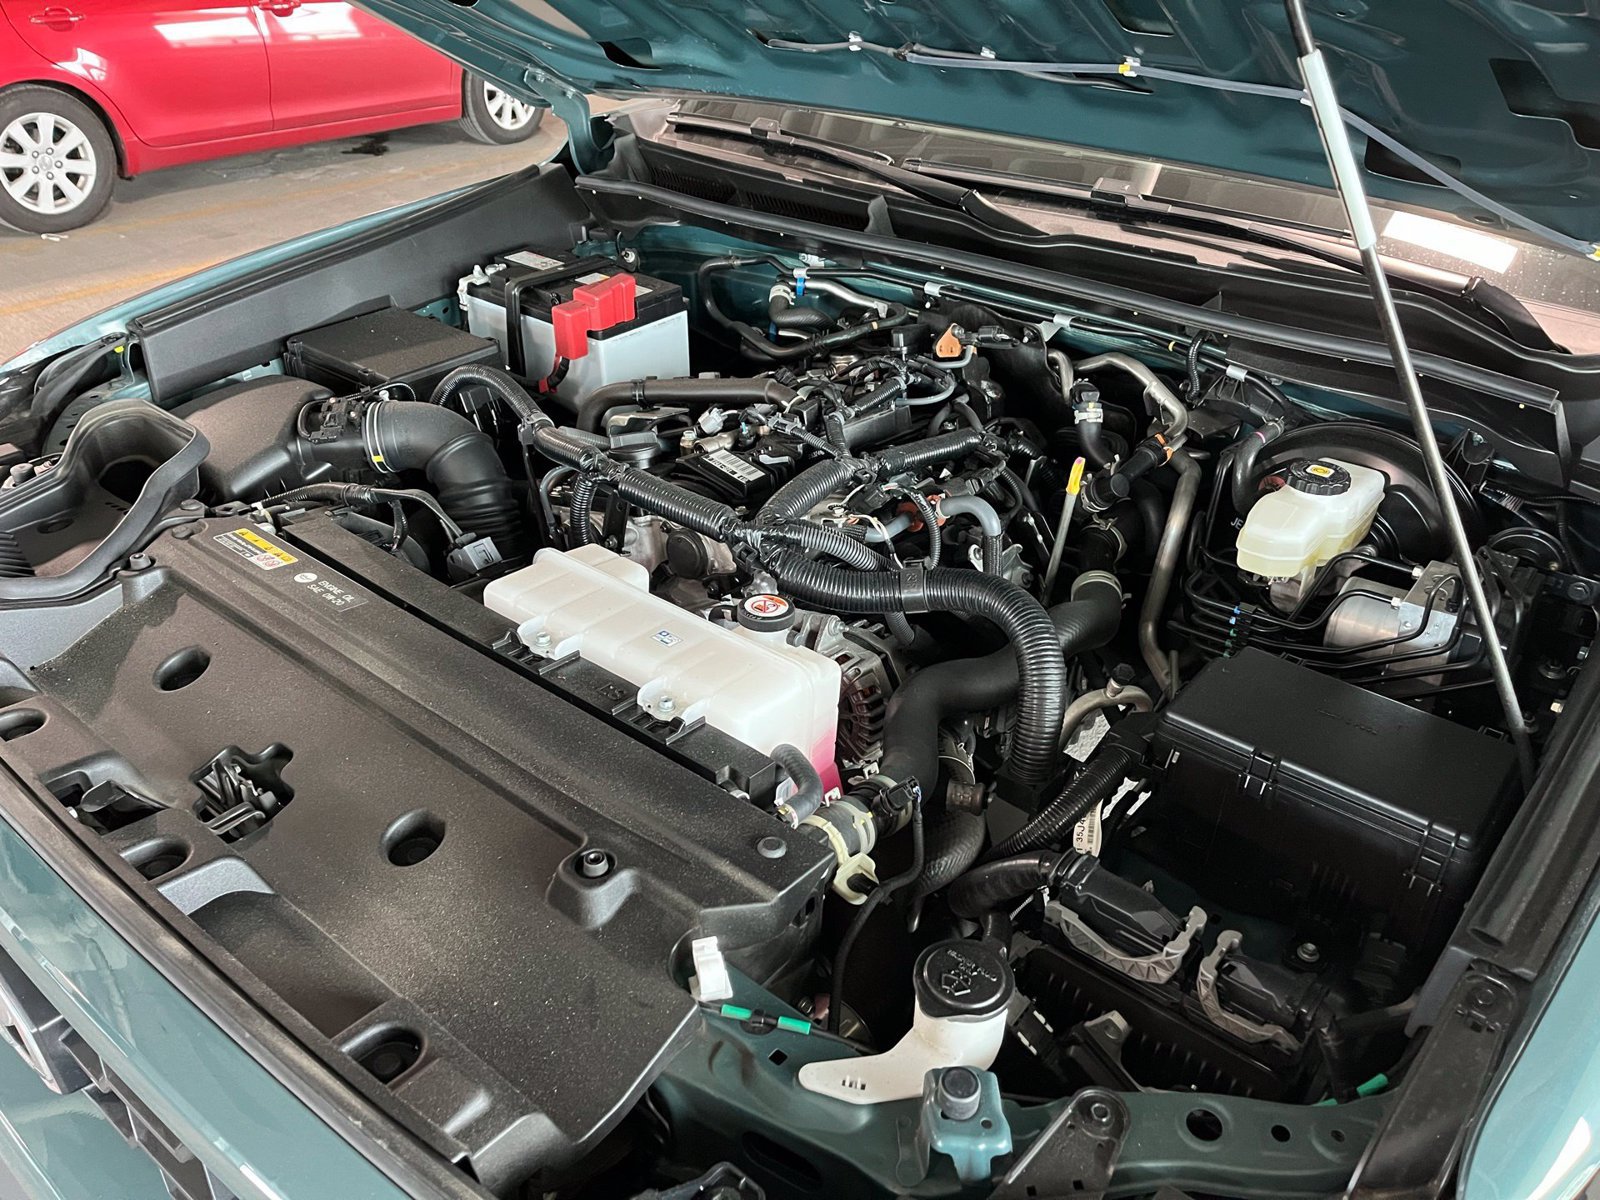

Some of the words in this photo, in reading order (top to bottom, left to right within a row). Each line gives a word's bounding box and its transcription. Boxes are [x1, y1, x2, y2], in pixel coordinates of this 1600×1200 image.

[307, 584, 325, 594] SAE
[318, 580, 344, 595] ENGINE
[342, 594, 355, 603] OIL
